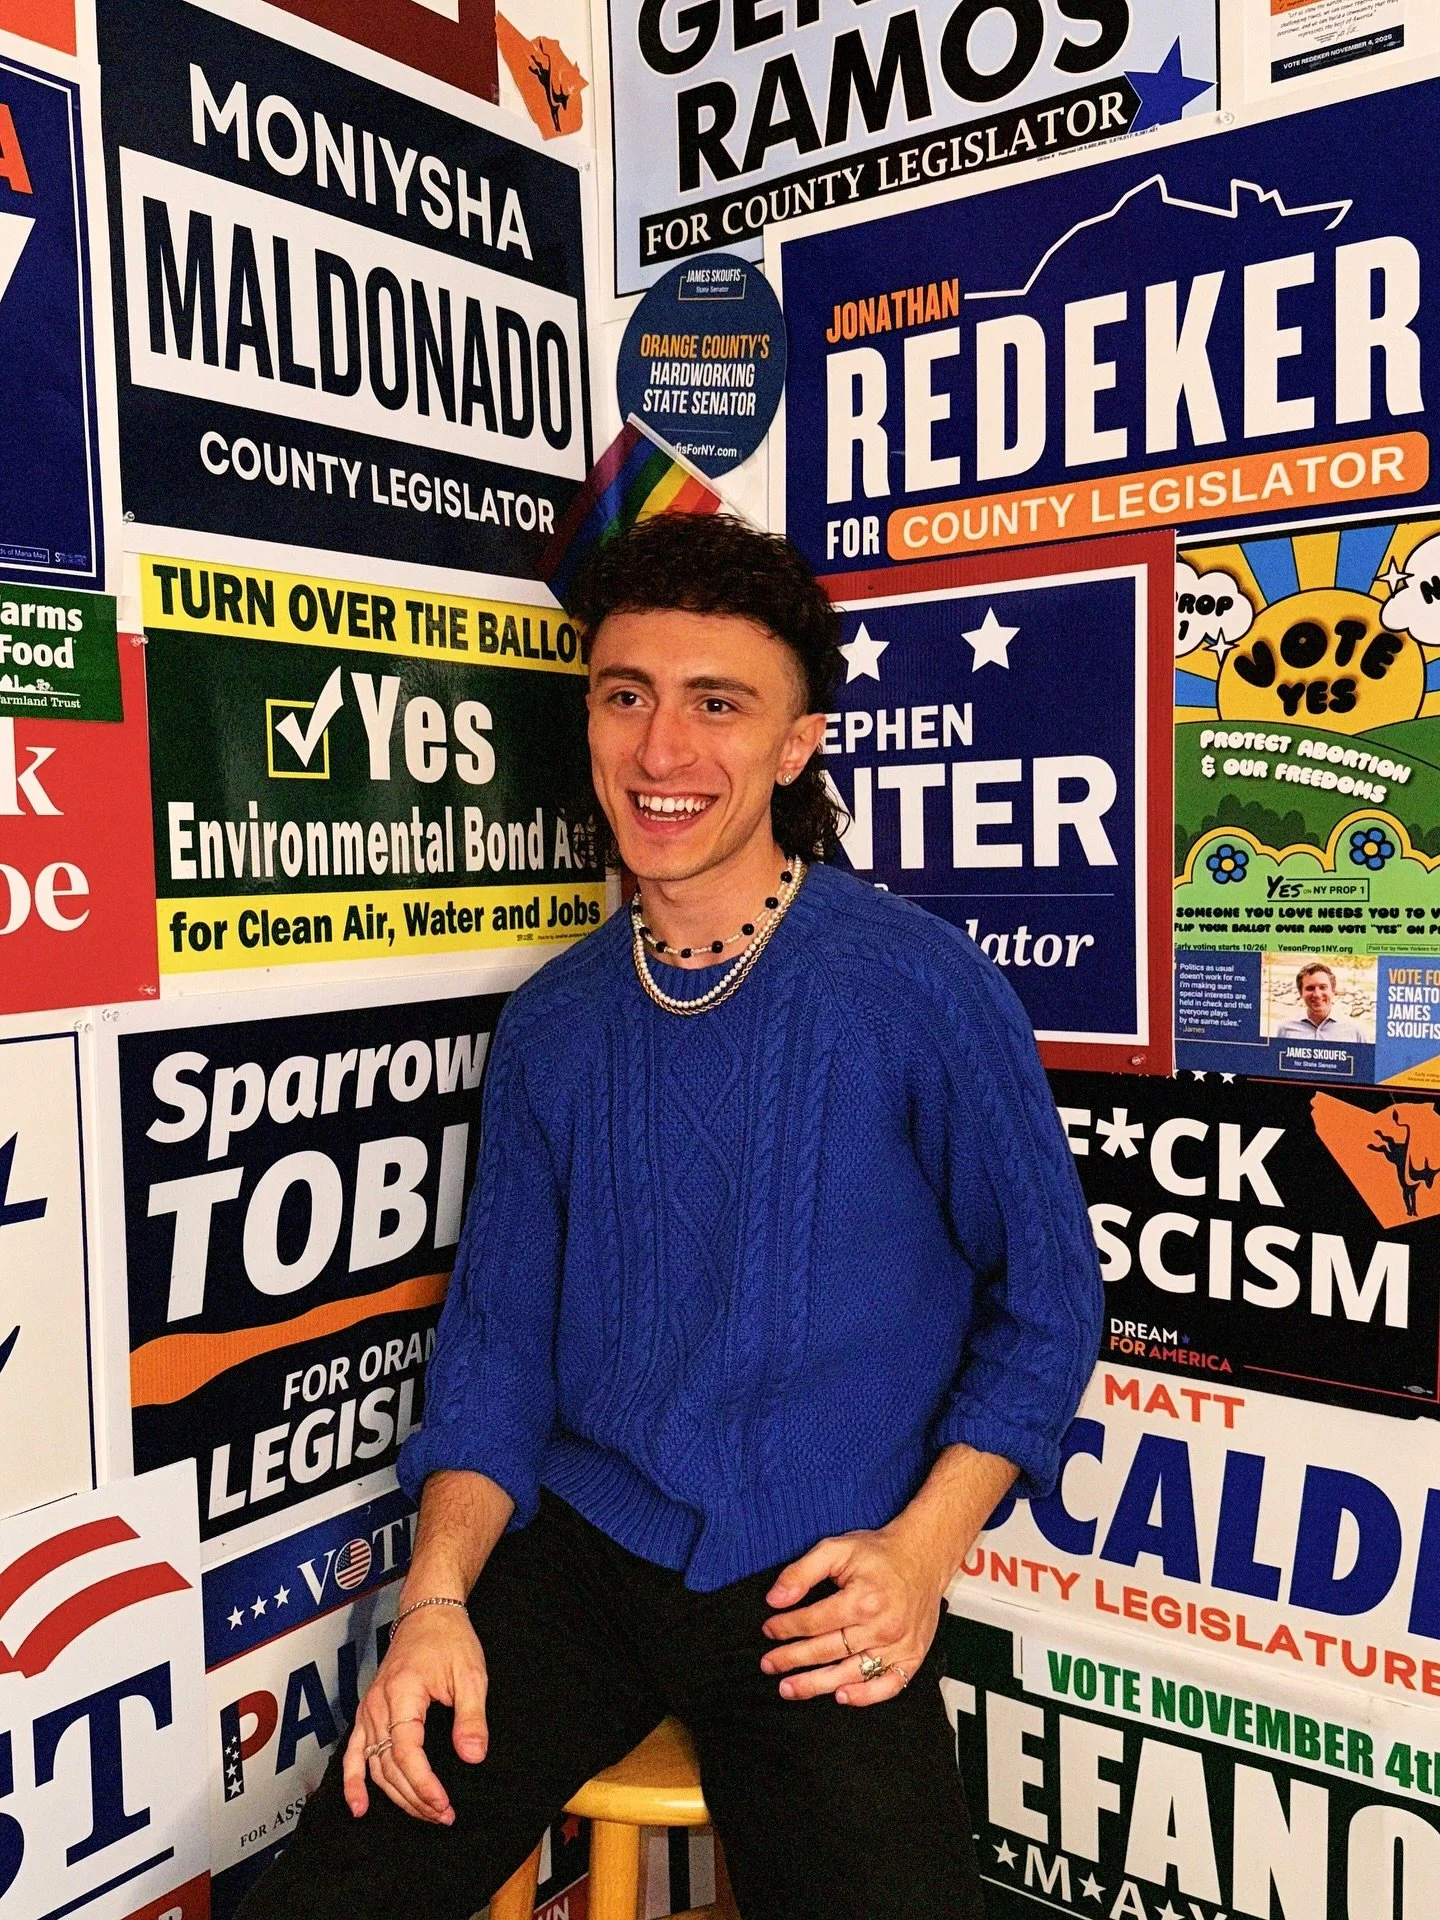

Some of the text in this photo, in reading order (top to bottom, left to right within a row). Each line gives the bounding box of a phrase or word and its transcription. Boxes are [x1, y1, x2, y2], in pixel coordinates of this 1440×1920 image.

[1283, 60, 1300, 69] VOTE
[1301, 51, 1331, 64] REDEKER
[1331, 41, 1367, 55] NOVEMBER
[678, 0, 1130, 192] RAMOS
[190, 63, 532, 260] MONIYSHA
[645, 215, 711, 256] FOR
[721, 165, 865, 235] COUNTY
[877, 92, 1128, 191] LEGISLATOR
[686, 268, 741, 283] JAMES SKOUFIS
[143, 196, 572, 450] MALDONADO
[826, 278, 959, 344] JONATHAN
[640, 333, 770, 359] ORANGE COUNTY'S
[650, 361, 756, 388] HARDWORKING
[826, 236, 1425, 505] REDEKER
[643, 389, 756, 416] STATE SENATOR
[200, 431, 555, 534] COUNTY LEGISLATOR
[827, 445, 1405, 560] FOR COUNTY LEGISLATOR
[0, 601, 83, 632] arms
[152, 564, 275, 628] TURN
[289, 581, 396, 641] OVER
[406, 601, 469, 651] THE
[1176, 590, 1234, 617] ROP
[0, 633, 74, 669] Food
[1233, 619, 1404, 688] VOTE
[50, 697, 82, 709] Trust
[1276, 678, 1357, 717] YES
[351, 672, 496, 784] Yes
[1200, 729, 1412, 784] PROTECT ABORTION
[1222, 758, 1269, 779] OUR
[1274, 762, 1388, 804] FREEDOMS
[167, 801, 455, 880] Environmental
[466, 807, 543, 872] Bond
[1313, 886, 1328, 895] NY
[1329, 886, 1357, 895] PROP
[169, 894, 601, 954] for Clean Air, Water and Jobs
[1176, 906, 1240, 918] SOMEONE
[1245, 907, 1274, 919] YOU
[1278, 907, 1313, 919] LOVE
[1318, 908, 1363, 919] NEEDS
[1368, 907, 1400, 919] YOU
[1405, 908, 1426, 919] TO
[1199, 924, 1228, 933] YOUR
[1232, 924, 1271, 933] BALLOT
[1275, 924, 1305, 934] OVER
[1309, 925, 1334, 934] AND
[1338, 925, 1367, 934] VOTE
[1406, 925, 1425, 935] ON
[1218, 943, 1240, 951] starts
[1242, 943, 1268, 951] 10/26!
[1278, 944, 1354, 954] YesonProp1NY.org
[1180, 963, 1204, 972] Politics
[1215, 964, 1234, 972] usual
[1205, 973, 1222, 981] work
[1223, 974, 1233, 982] for
[1389, 968, 1422, 985] VOTE
[1179, 998, 1196, 1007] held
[1203, 1000, 1223, 1009] check
[1224, 1001, 1237, 1009] and
[1180, 989, 1203, 999] special
[1204, 991, 1234, 999] interests
[1192, 982, 1216, 991] making
[1179, 1009, 1228, 1018] everyone plays
[1179, 1017, 1187, 1026] by
[1188, 1017, 1199, 1025] the
[1387, 1003, 1431, 1021] JAMES
[1387, 1021, 1440, 1039] SKOUFIS
[1286, 1047, 1347, 1061] JAMES SKOUFIS
[145, 1031, 491, 1161] Sparrow
[147, 1122, 469, 1324] TOBI
[1086, 1203, 1411, 1330] SCISM
[1110, 1317, 1178, 1345] DREAM
[1110, 1335, 1232, 1374] FOR AMERICA
[283, 1356, 350, 1411] FOR
[1104, 1374, 1245, 1430] MATT
[979, 1418, 1440, 1640] CALD
[1095, 1579, 1440, 1697] LEGISLATURE
[1047, 1650, 1142, 1715] VOTE
[1151, 1677, 1374, 1779] NOVEMBER
[240, 1824, 268, 1848] FOR
